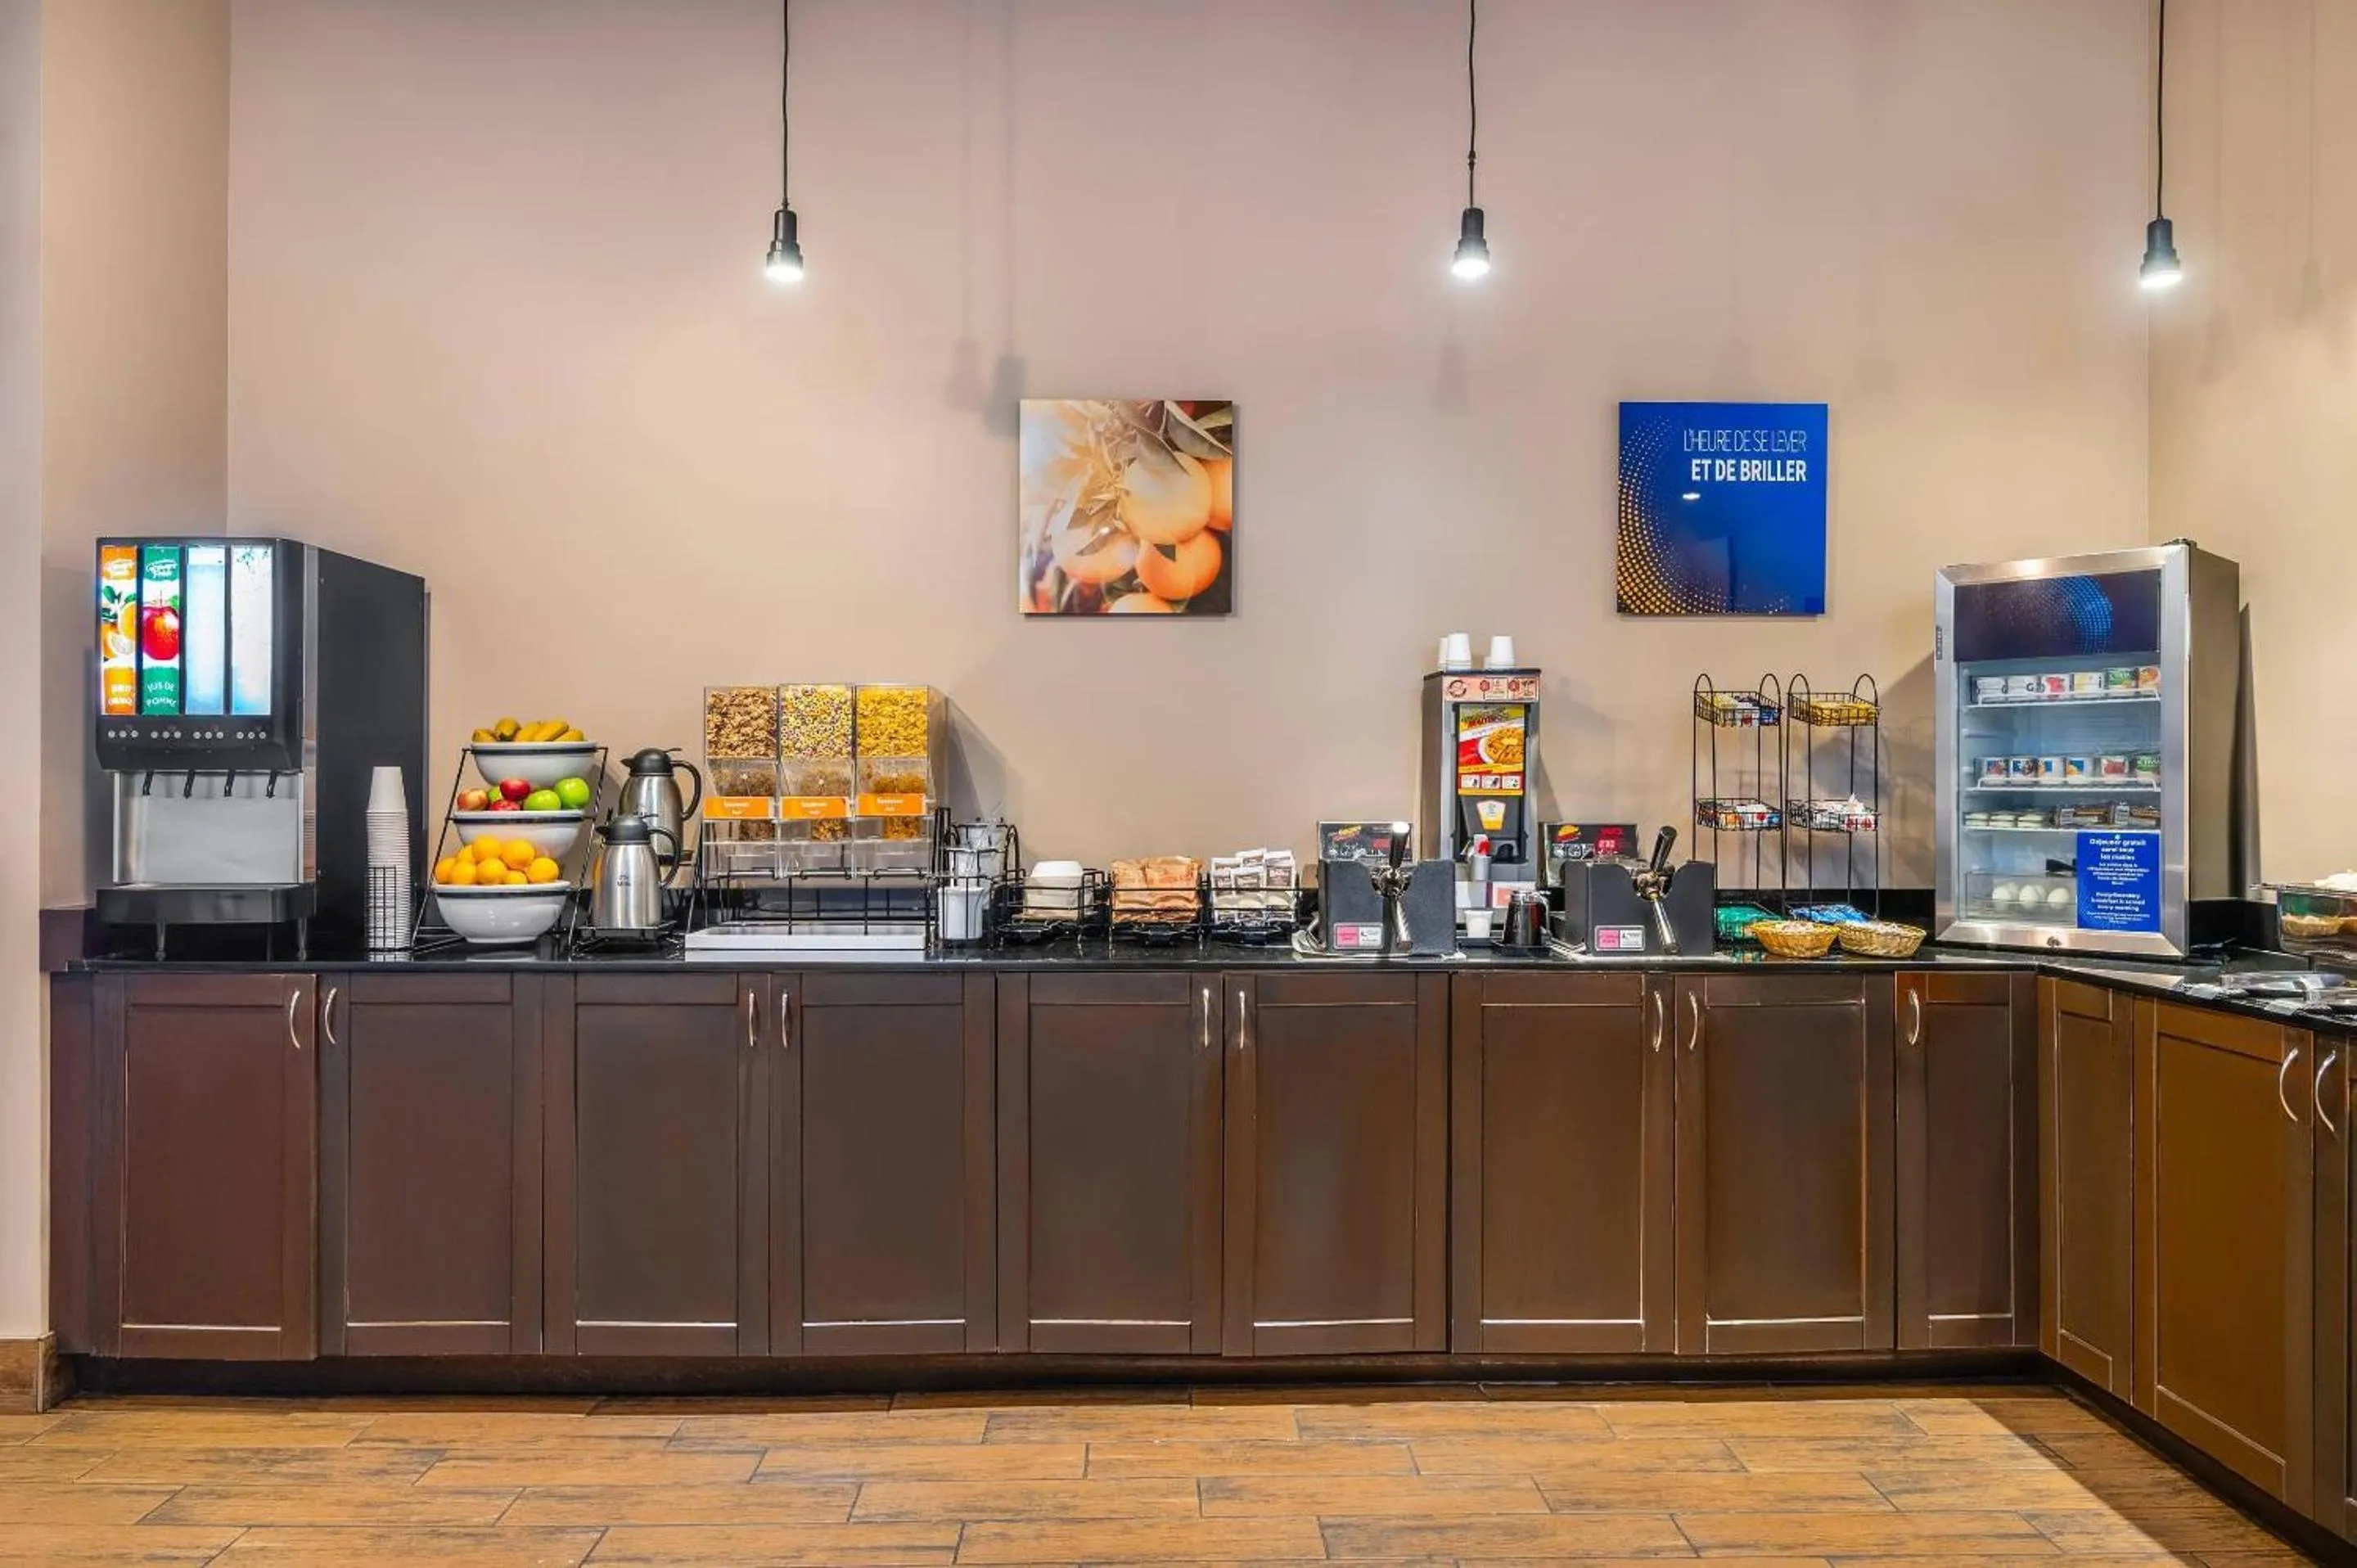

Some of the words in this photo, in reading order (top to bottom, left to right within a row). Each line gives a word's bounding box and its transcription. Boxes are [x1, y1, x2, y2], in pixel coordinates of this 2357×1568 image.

[1683, 428, 1733, 452] L'HEURE
[1734, 430, 1751, 452] DE
[1753, 430, 1769, 453] SE
[1771, 430, 1806, 453] LEVER
[1691, 458, 1712, 482] ET
[1715, 458, 1737, 482] DE
[1739, 459, 1807, 482] BRILLER
